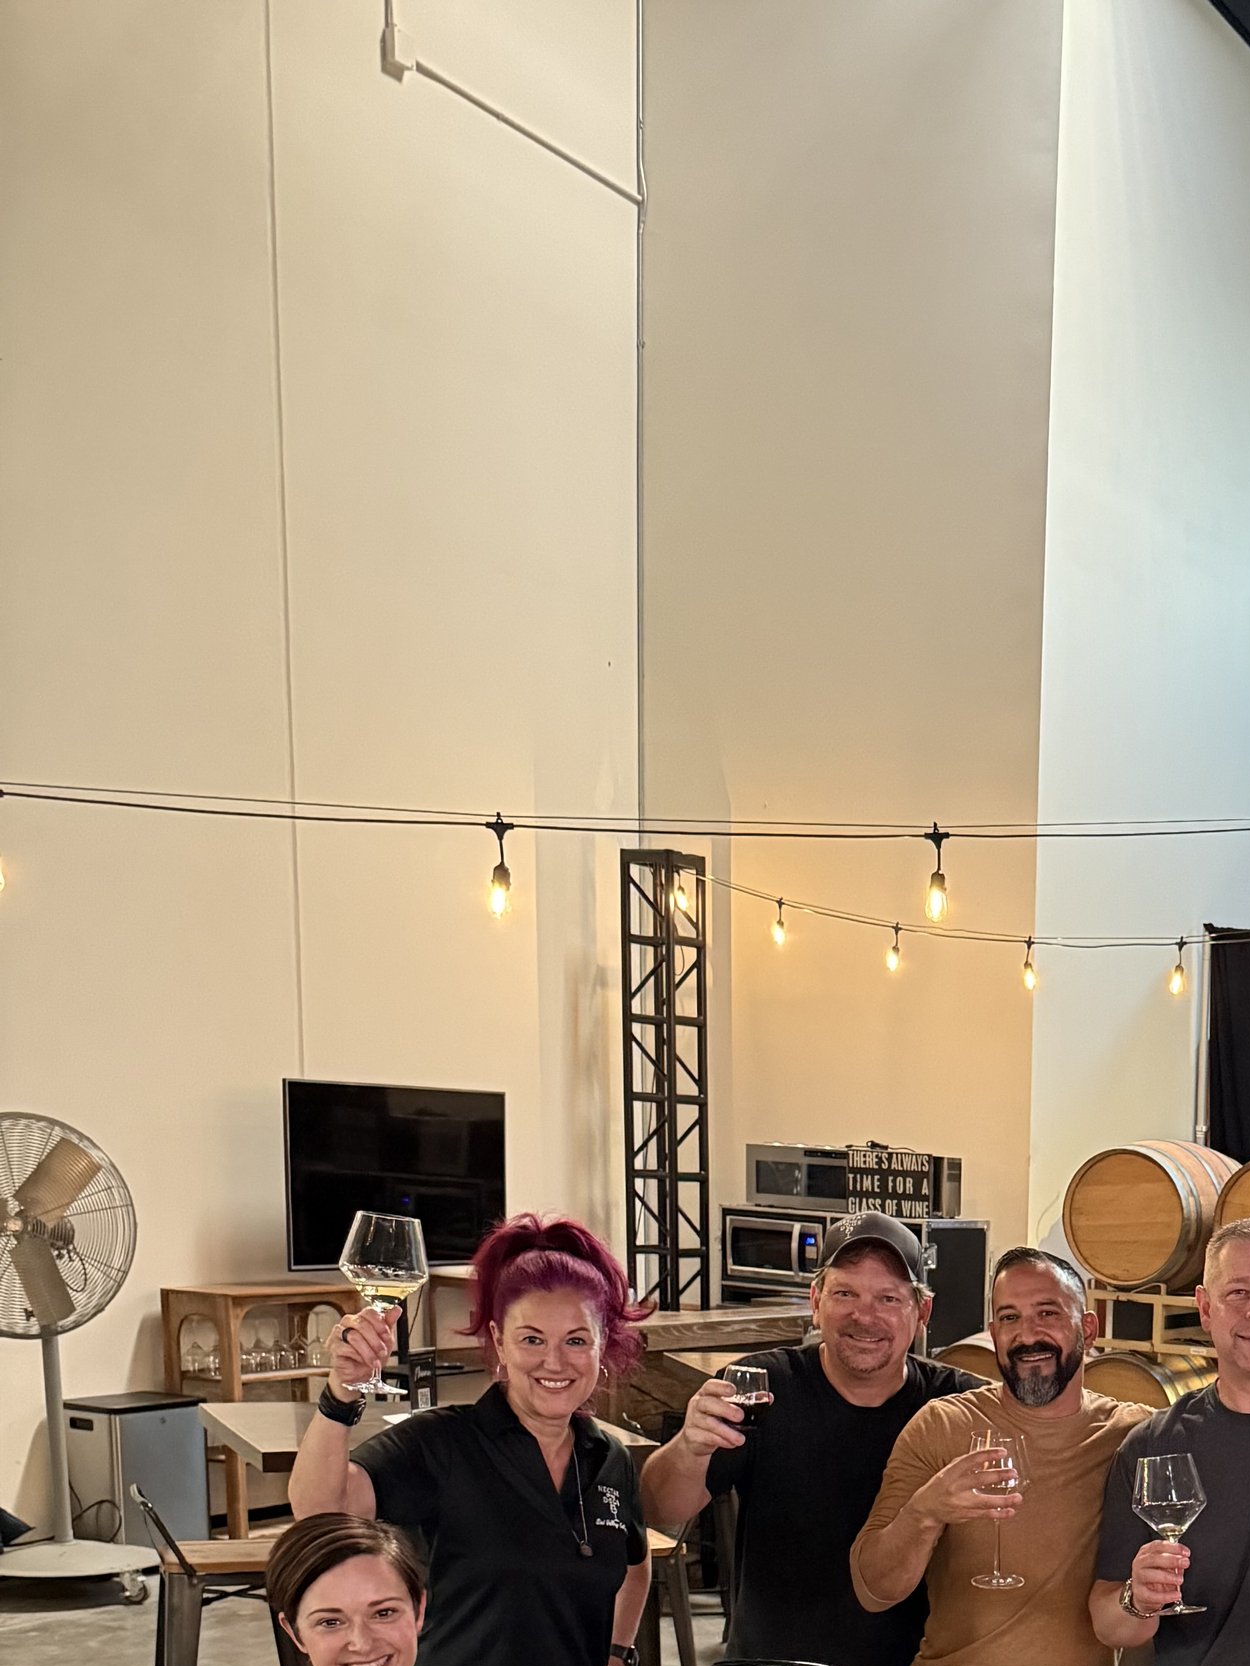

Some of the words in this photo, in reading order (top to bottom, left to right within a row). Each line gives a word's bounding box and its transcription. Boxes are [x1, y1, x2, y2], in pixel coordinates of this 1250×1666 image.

[847, 1150, 889, 1170] THERE'S
[891, 1153, 929, 1172] ALWAYS
[848, 1173, 881, 1193] TIME
[888, 1175, 914, 1195] FOR
[921, 1178, 930, 1196] A
[848, 1197, 882, 1214] GLASS
[885, 1199, 898, 1217] OF
[901, 1200, 929, 1218] WINE
